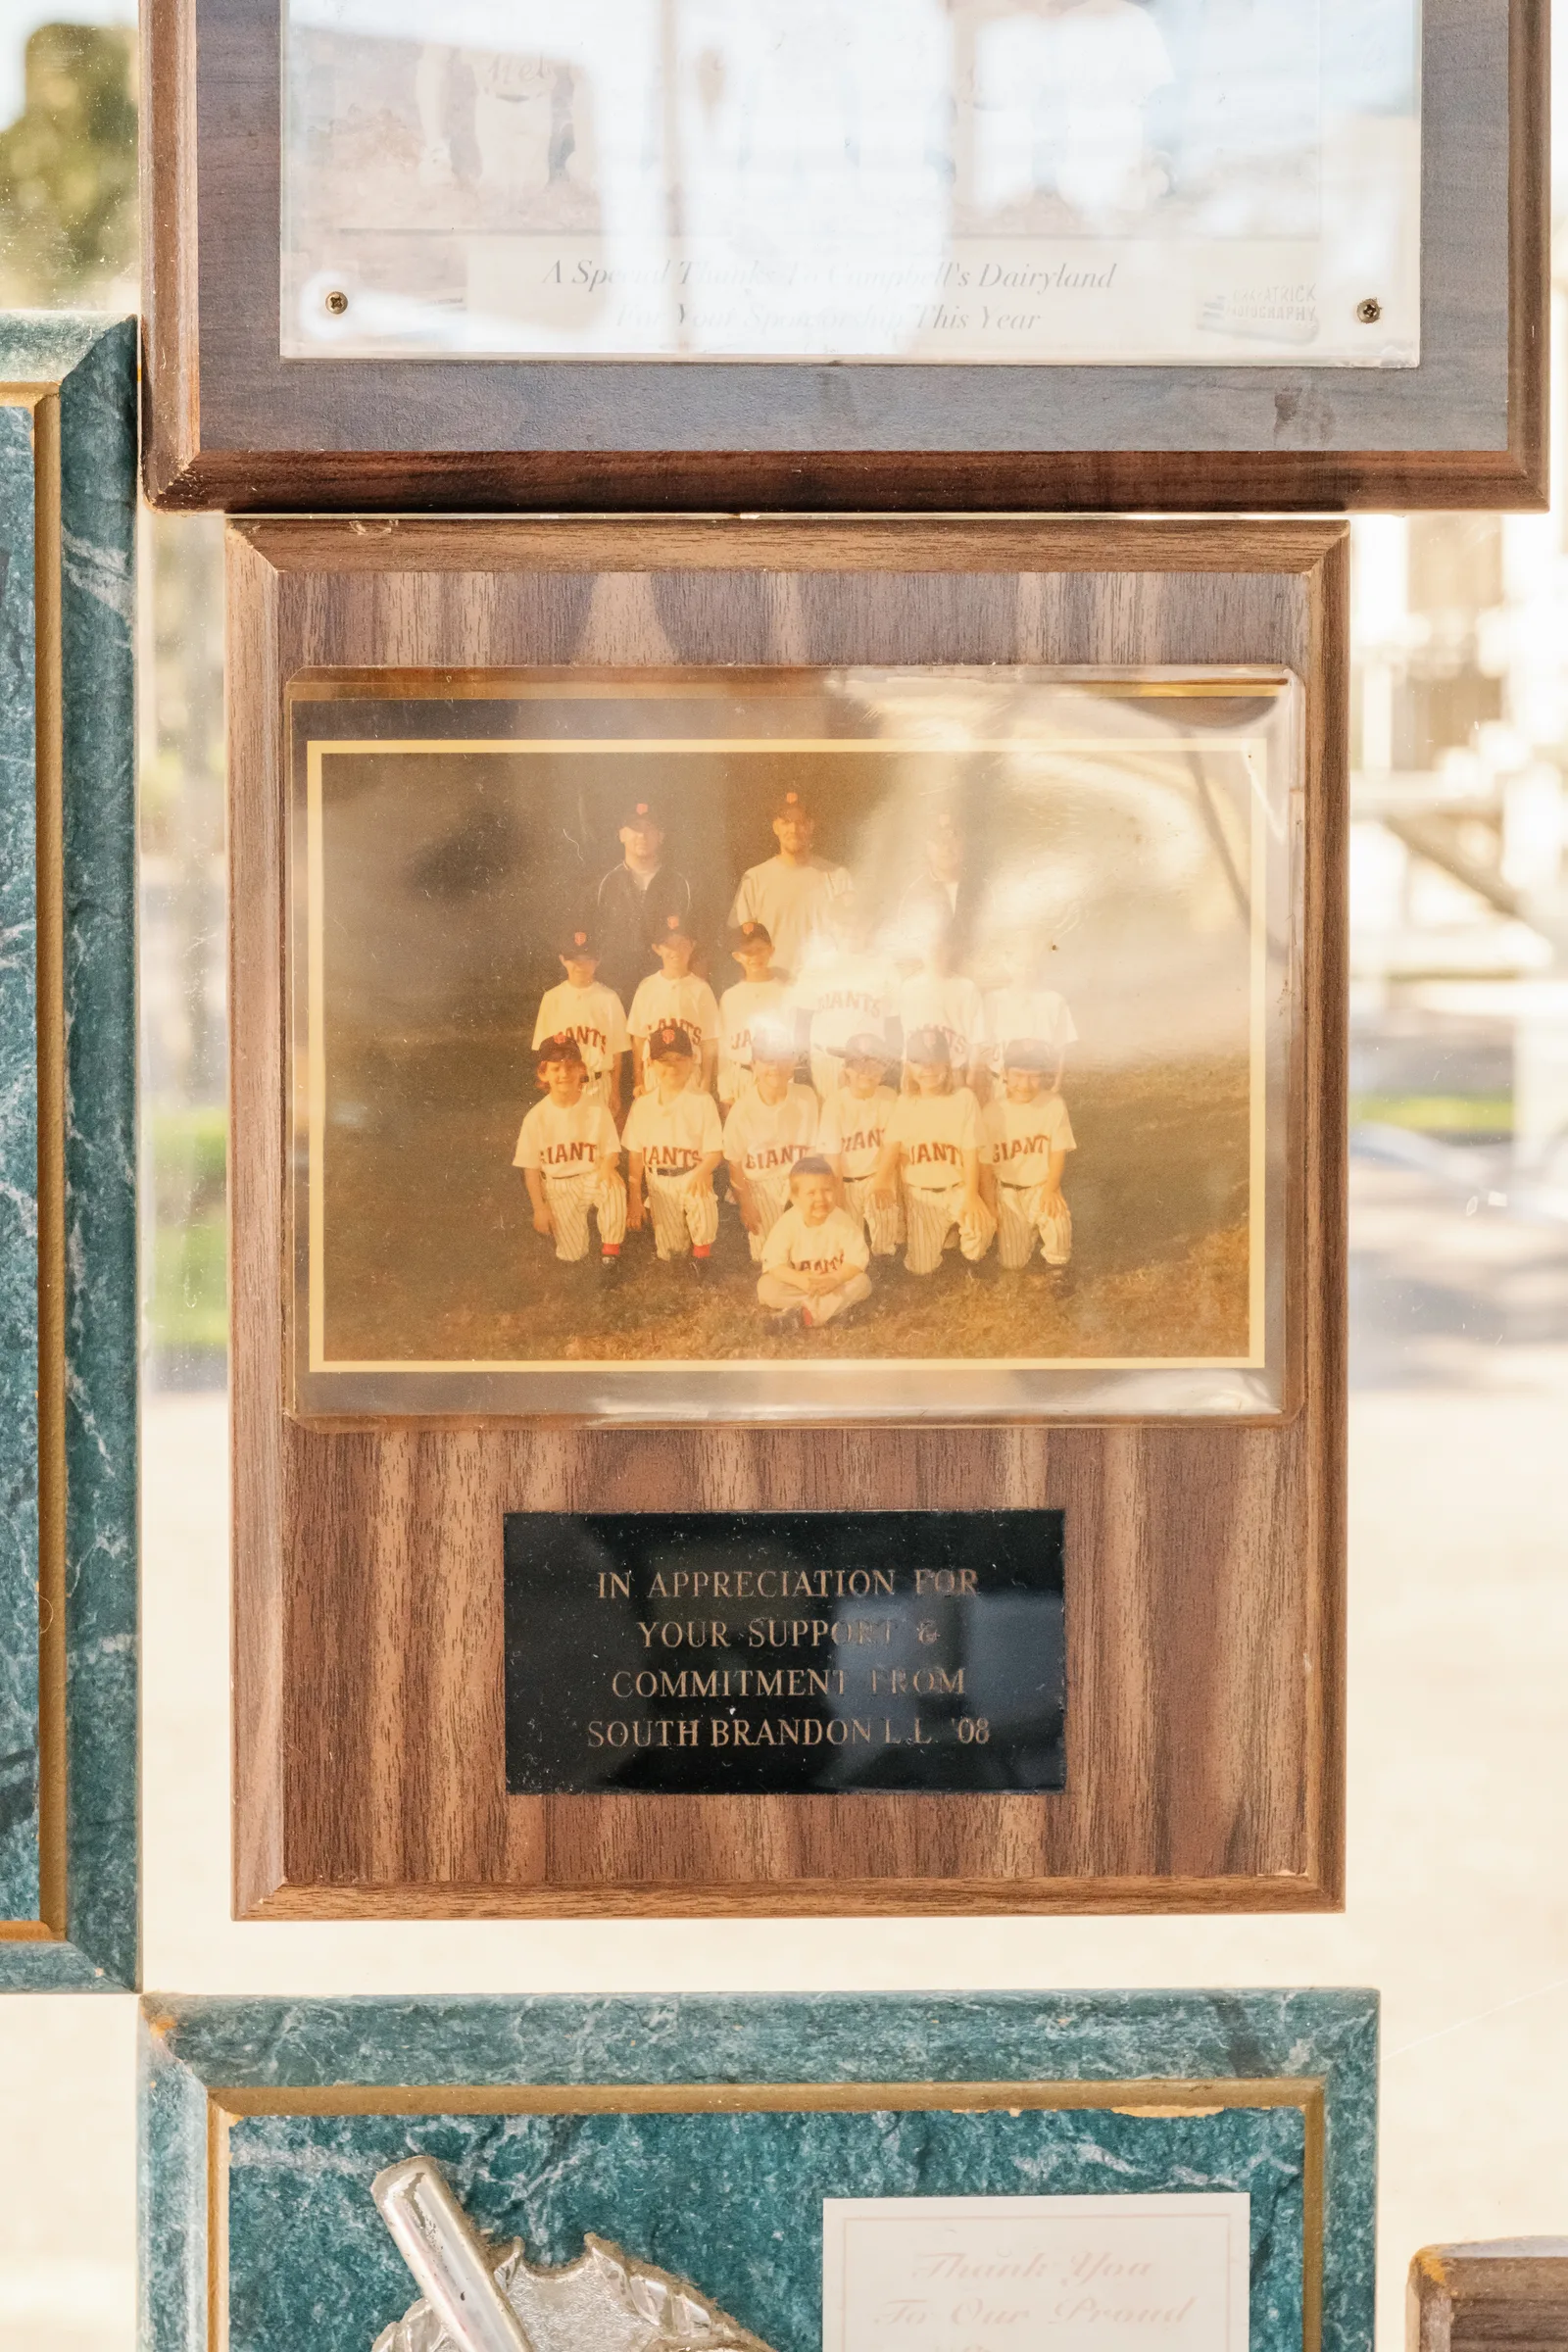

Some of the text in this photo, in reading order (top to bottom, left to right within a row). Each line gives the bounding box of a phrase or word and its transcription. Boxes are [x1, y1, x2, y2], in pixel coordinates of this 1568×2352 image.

[542, 259, 563, 284] A
[571, 259, 671, 293] Special
[678, 259, 776, 285] Thanks
[827, 262, 969, 294] Campbell's
[978, 263, 1117, 296] Dairyland
[616, 302, 1044, 337] For Your Sponsorship This Year
[597, 1568, 978, 1599] IN APPRECIATION FOR
[636, 1619, 941, 1648] YOUR SUPPORT &
[612, 1668, 965, 1699] COMMITMENT FROM
[588, 1719, 700, 1748] SOUTH
[710, 1718, 872, 1747] BRANDON
[951, 1717, 991, 1744] '08
[909, 2251, 1154, 2287] Thank You
[872, 2296, 1199, 2328] To Our Proud
